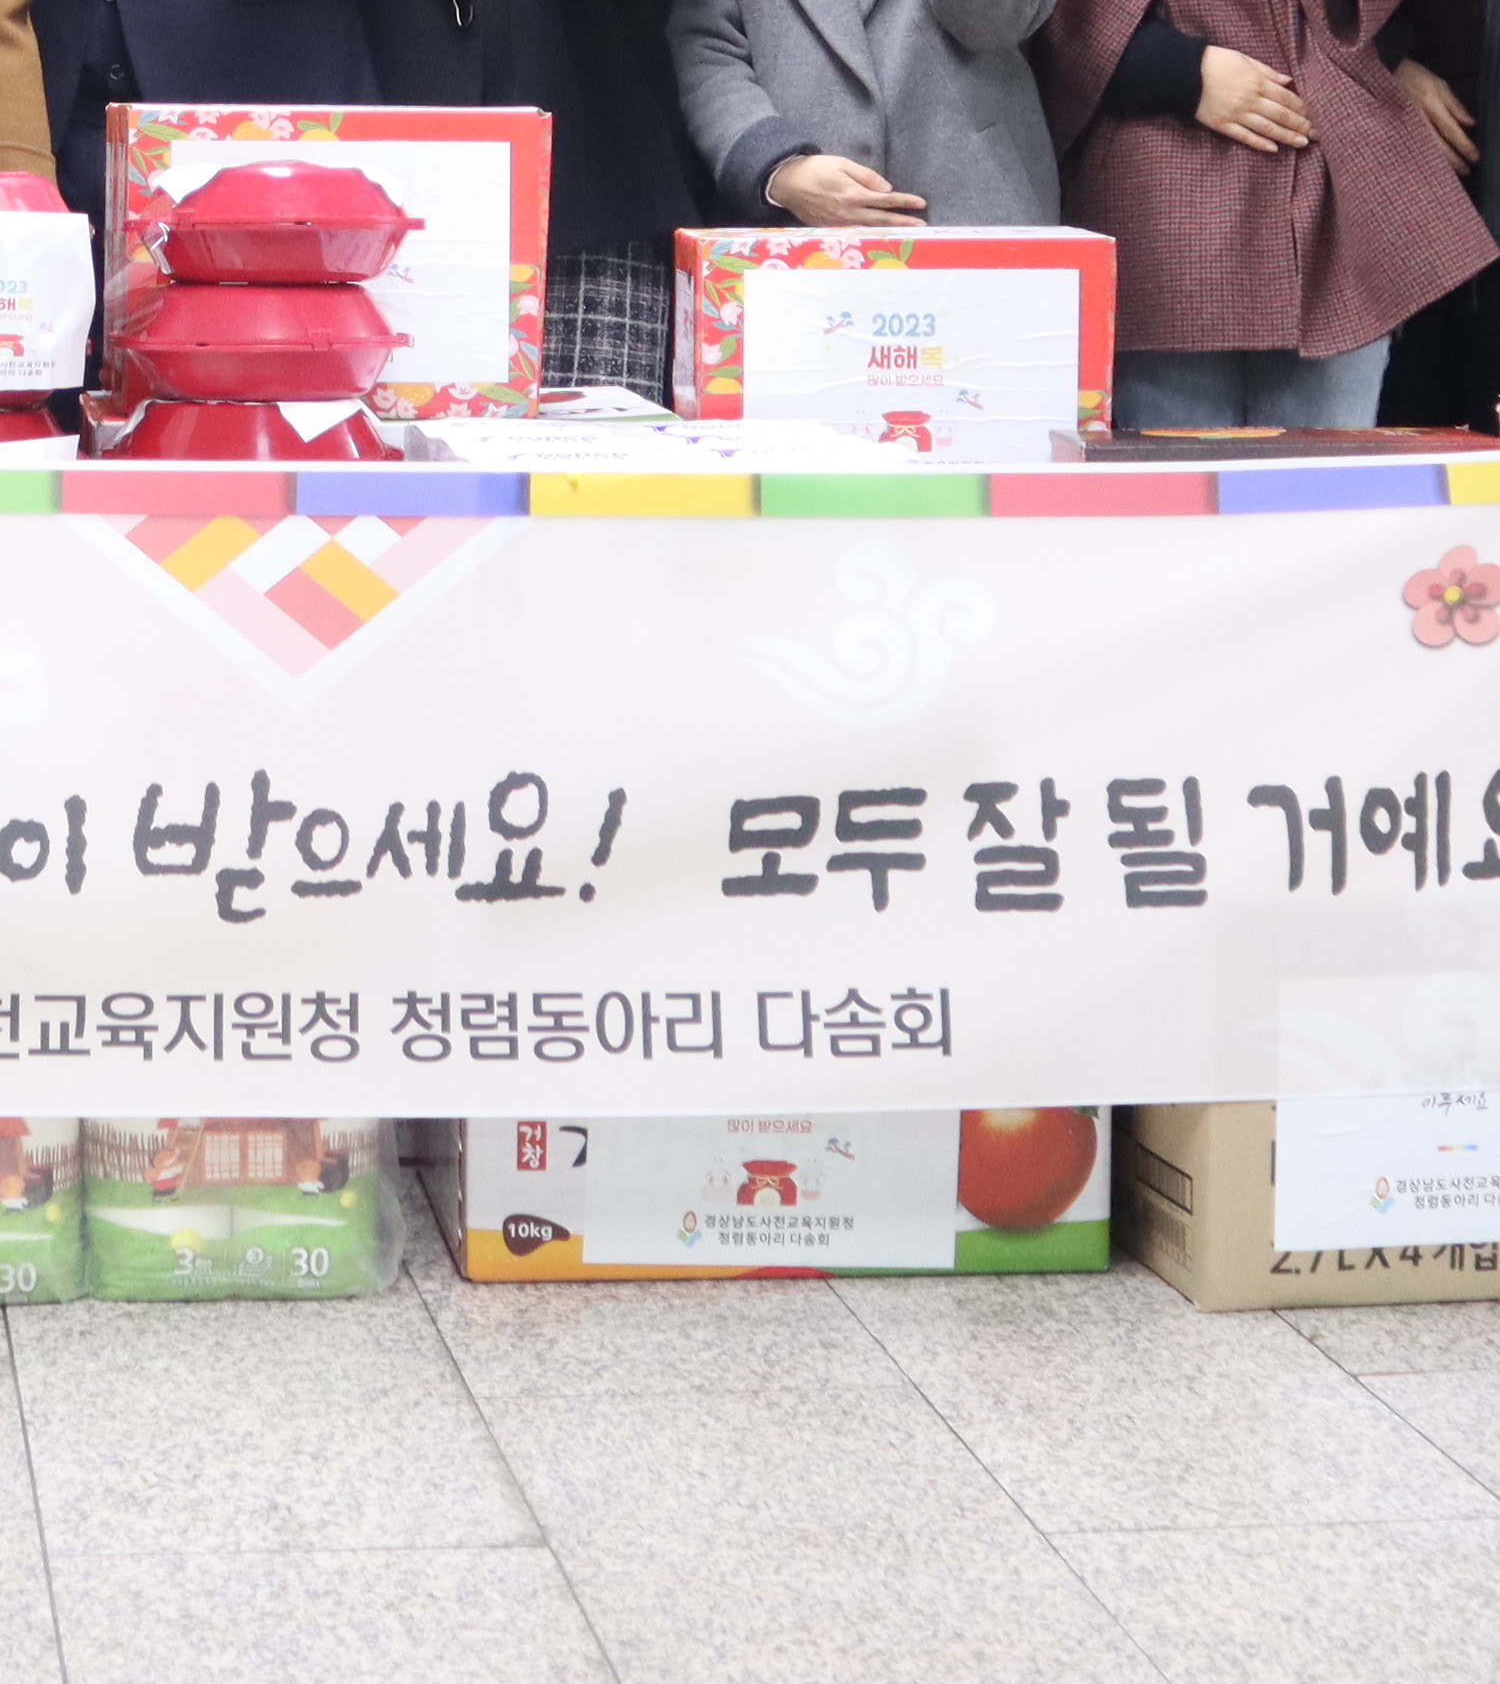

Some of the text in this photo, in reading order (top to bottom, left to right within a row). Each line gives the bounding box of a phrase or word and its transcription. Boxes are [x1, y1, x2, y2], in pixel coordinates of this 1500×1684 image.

[872, 313, 936, 337] 2023
[867, 345, 918, 370] 새해
[867, 374, 944, 387] 많이 받으세요
[132, 768, 626, 923] 받으세요!
[721, 786, 927, 912] 모두
[963, 778, 1070, 912] 잘
[1106, 777, 1207, 909] 될
[392, 992, 722, 1060] 청렴동아리
[756, 988, 951, 1058] 다솜회
[727, 1119, 813, 1134] 많이 받으세요
[517, 1125, 544, 1169] 거창
[1412, 1193, 1480, 1210] 청렴동아리
[507, 1220, 553, 1241] 10kg
[705, 1214, 855, 1230] 경상남도사천교육지원청
[718, 1231, 830, 1247] 청렴동아리 다솜회
[290, 1246, 330, 1278] 30
